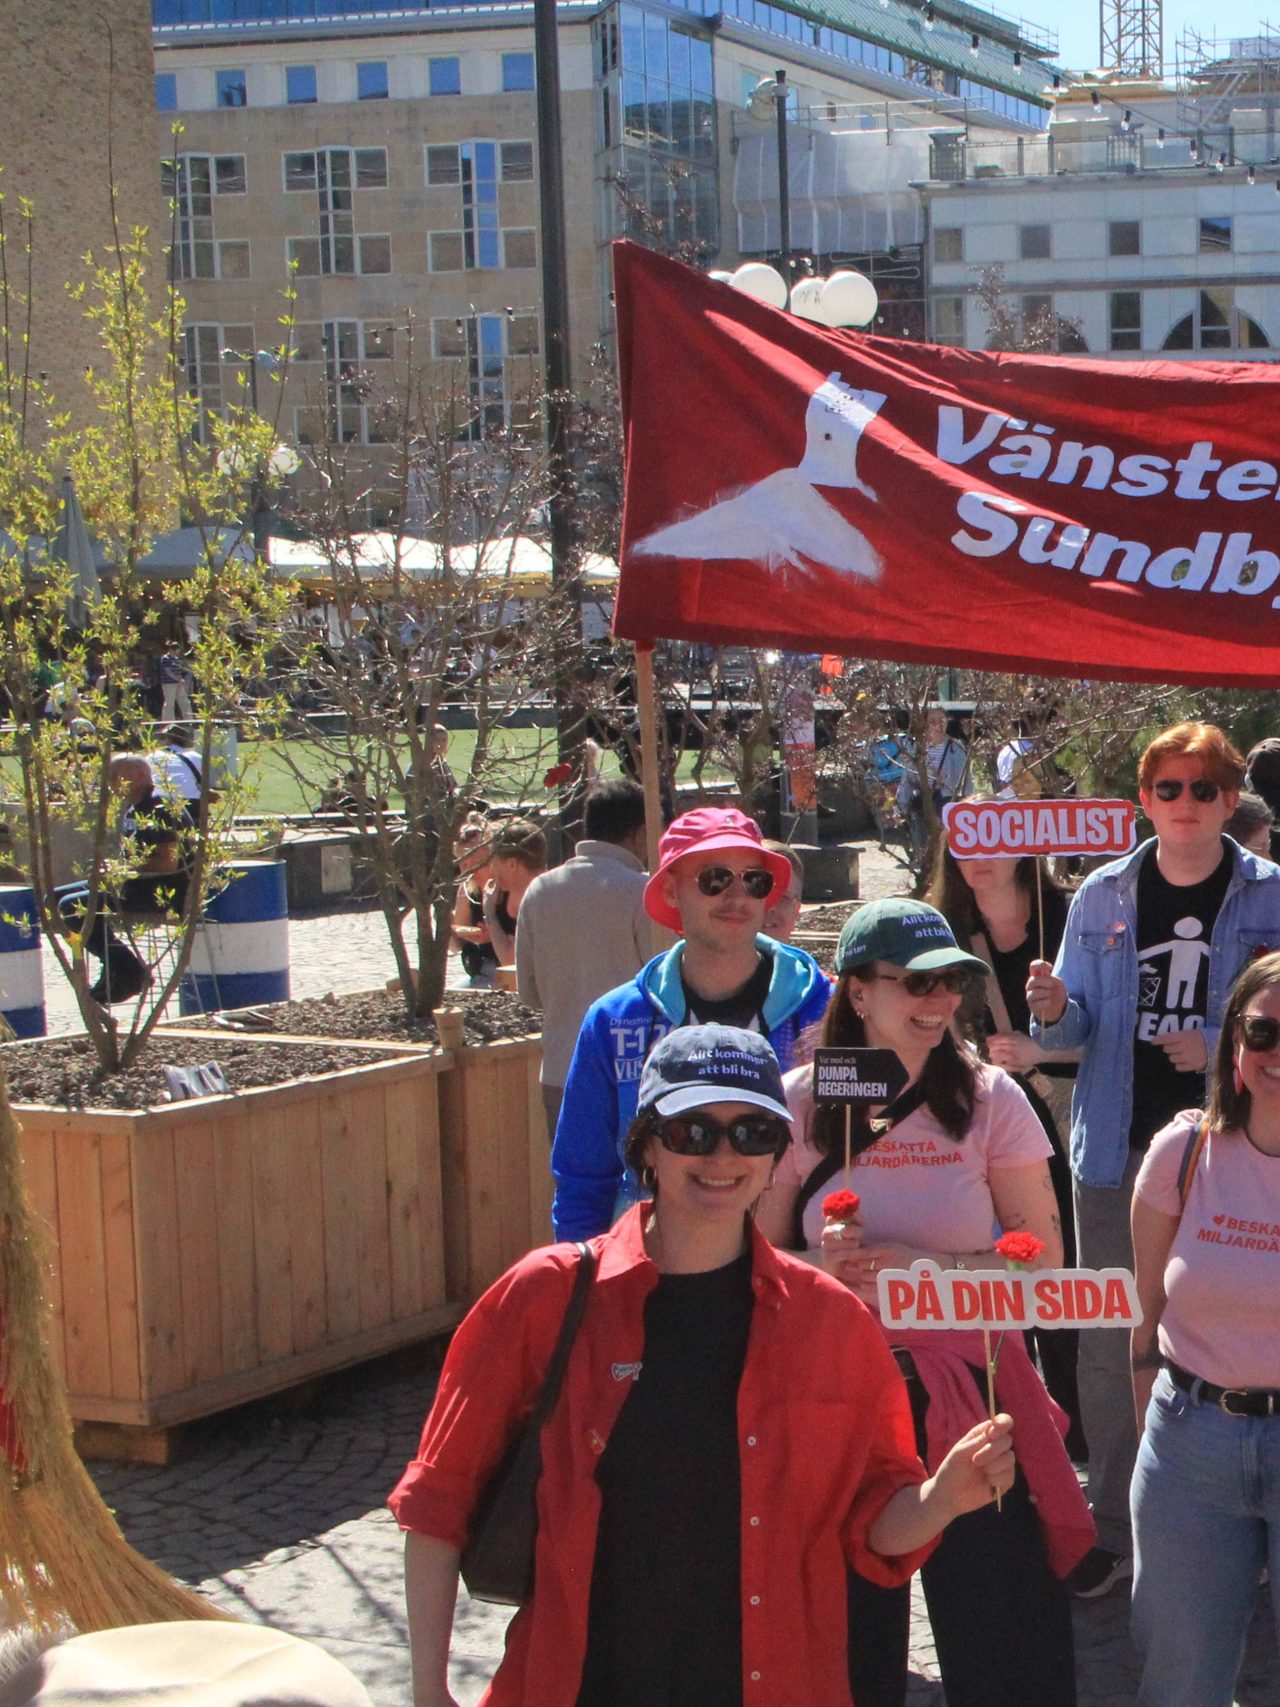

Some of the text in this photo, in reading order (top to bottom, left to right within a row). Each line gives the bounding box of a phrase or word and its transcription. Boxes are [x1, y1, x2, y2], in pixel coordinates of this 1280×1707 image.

[955, 808, 1127, 848] SOCIALIST
[698, 1064, 760, 1079] att bli bra
[818, 1066, 858, 1081] DUMPA
[818, 1082, 887, 1097] REGERINGEN
[851, 1151, 964, 1169] ILJARDÄRERNA
[887, 1270, 1132, 1321] PÅ DIN SIDA
